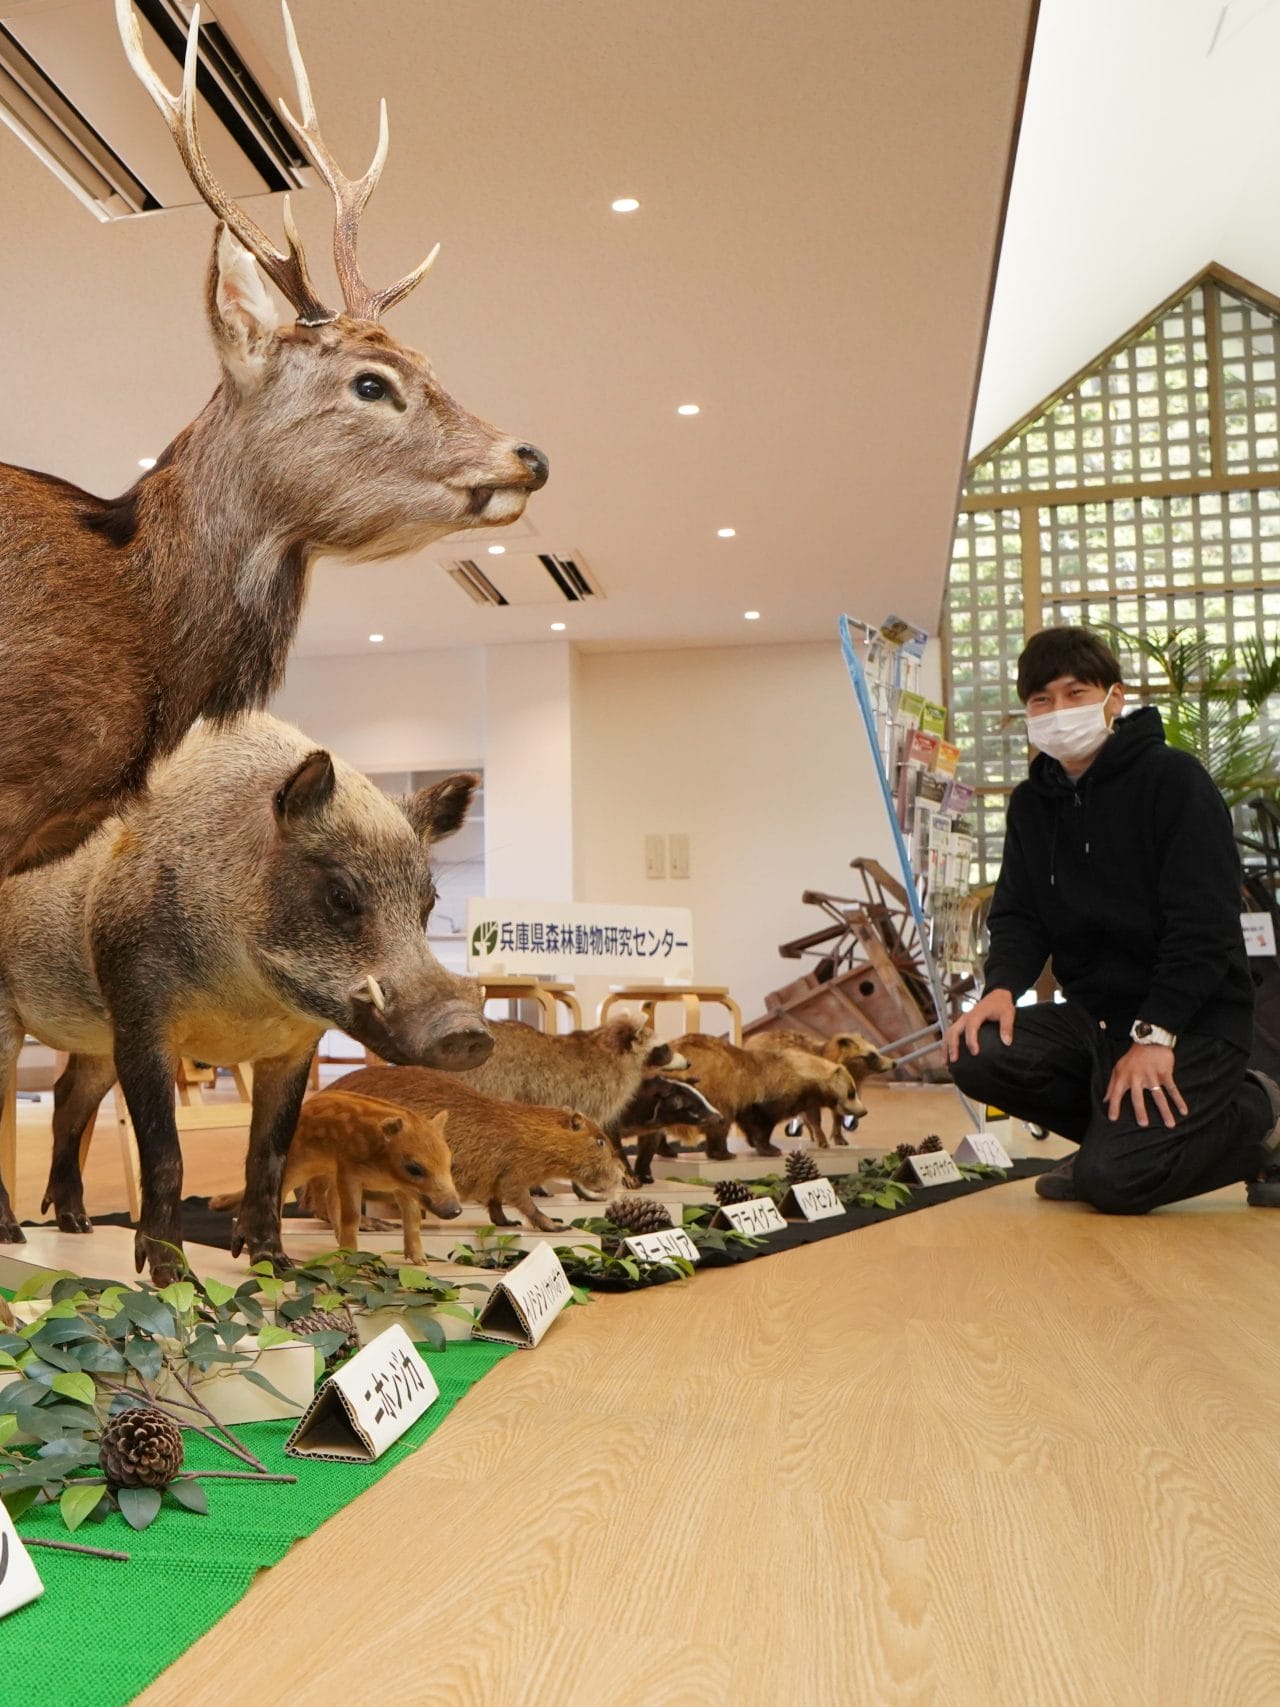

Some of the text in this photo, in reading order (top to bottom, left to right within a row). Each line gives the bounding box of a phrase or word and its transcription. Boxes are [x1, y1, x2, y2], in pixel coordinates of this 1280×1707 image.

[500, 921, 688, 958] 兵庫県森林動物研究センター
[802, 1186, 839, 1212] ハクビシン
[731, 1203, 782, 1233] アライグマ
[635, 1233, 694, 1260] ヌートリア
[364, 1348, 425, 1425] ニホンジカ
